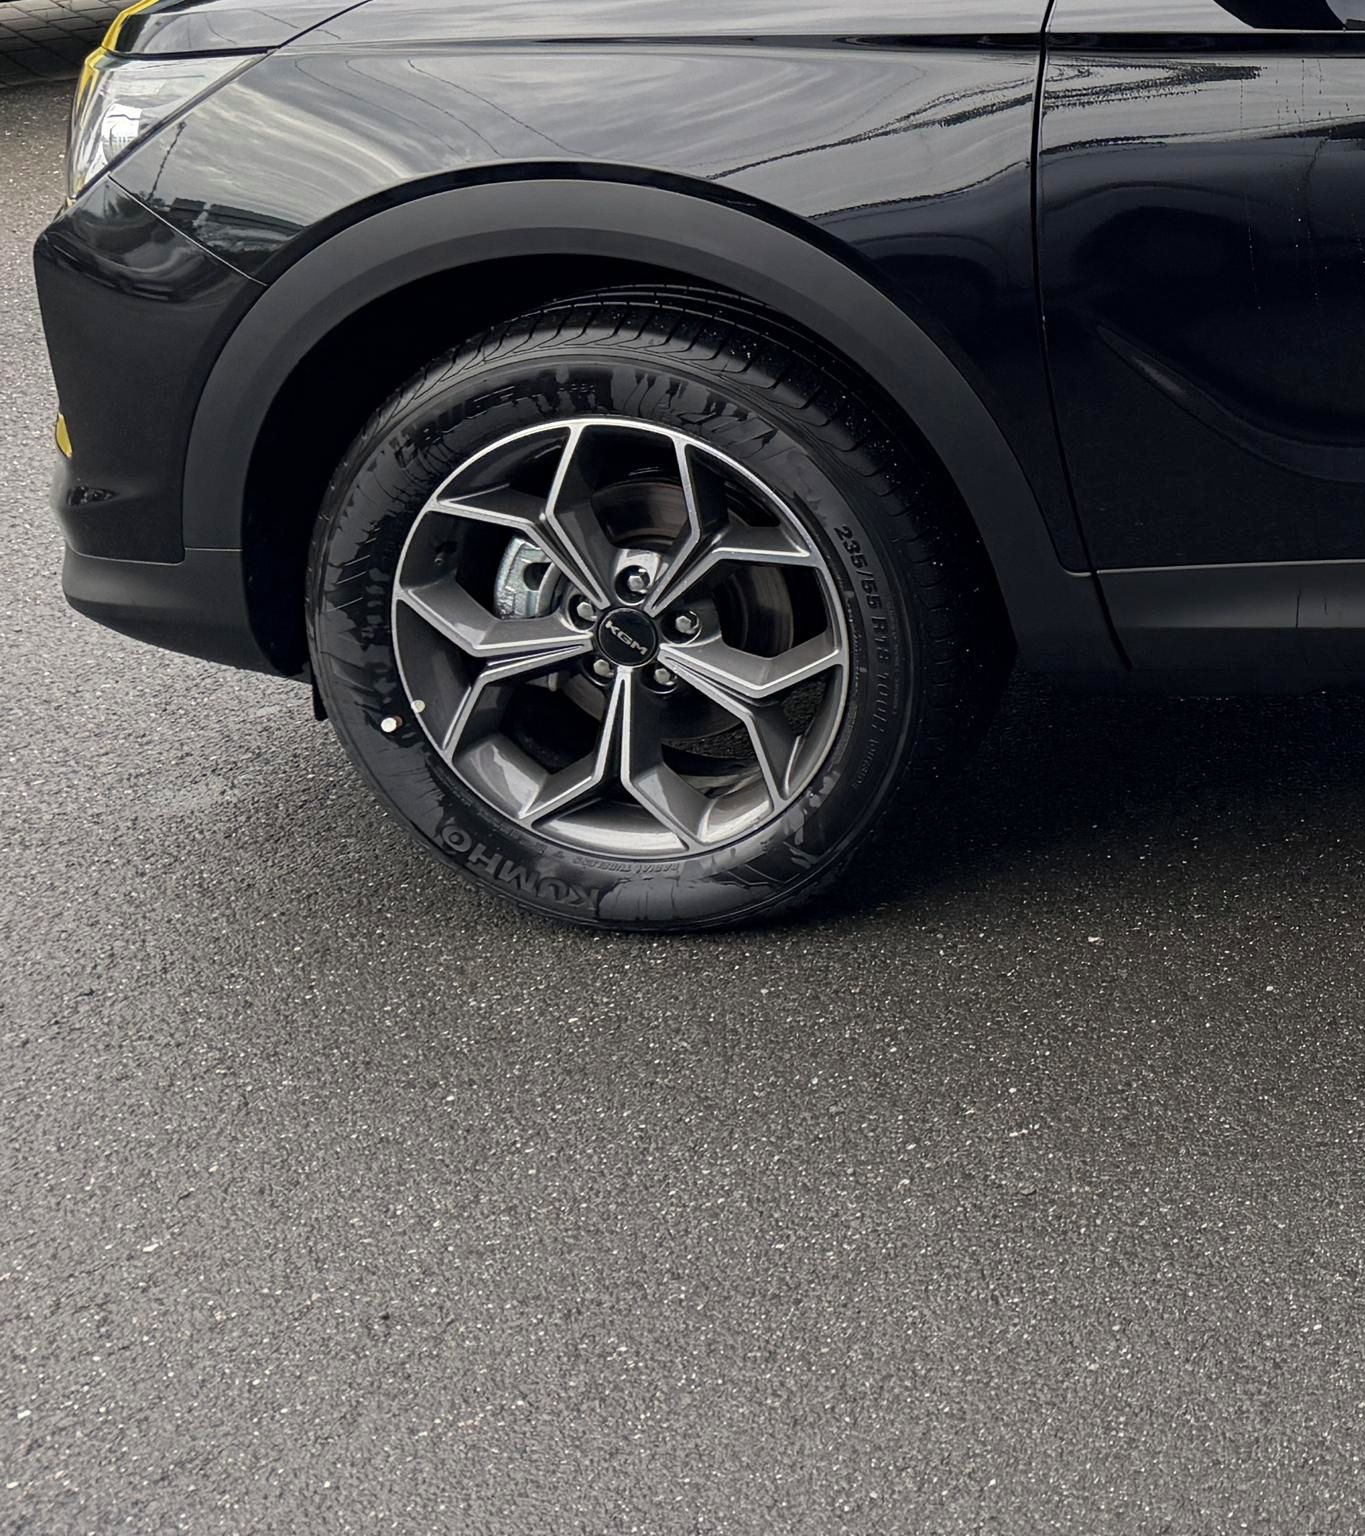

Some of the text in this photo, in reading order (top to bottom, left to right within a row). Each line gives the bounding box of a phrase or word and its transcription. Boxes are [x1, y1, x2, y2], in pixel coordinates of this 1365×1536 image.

[833, 523, 885, 610] 235/55
[605, 620, 648, 655] KGM
[440, 822, 600, 911] KUMHO
